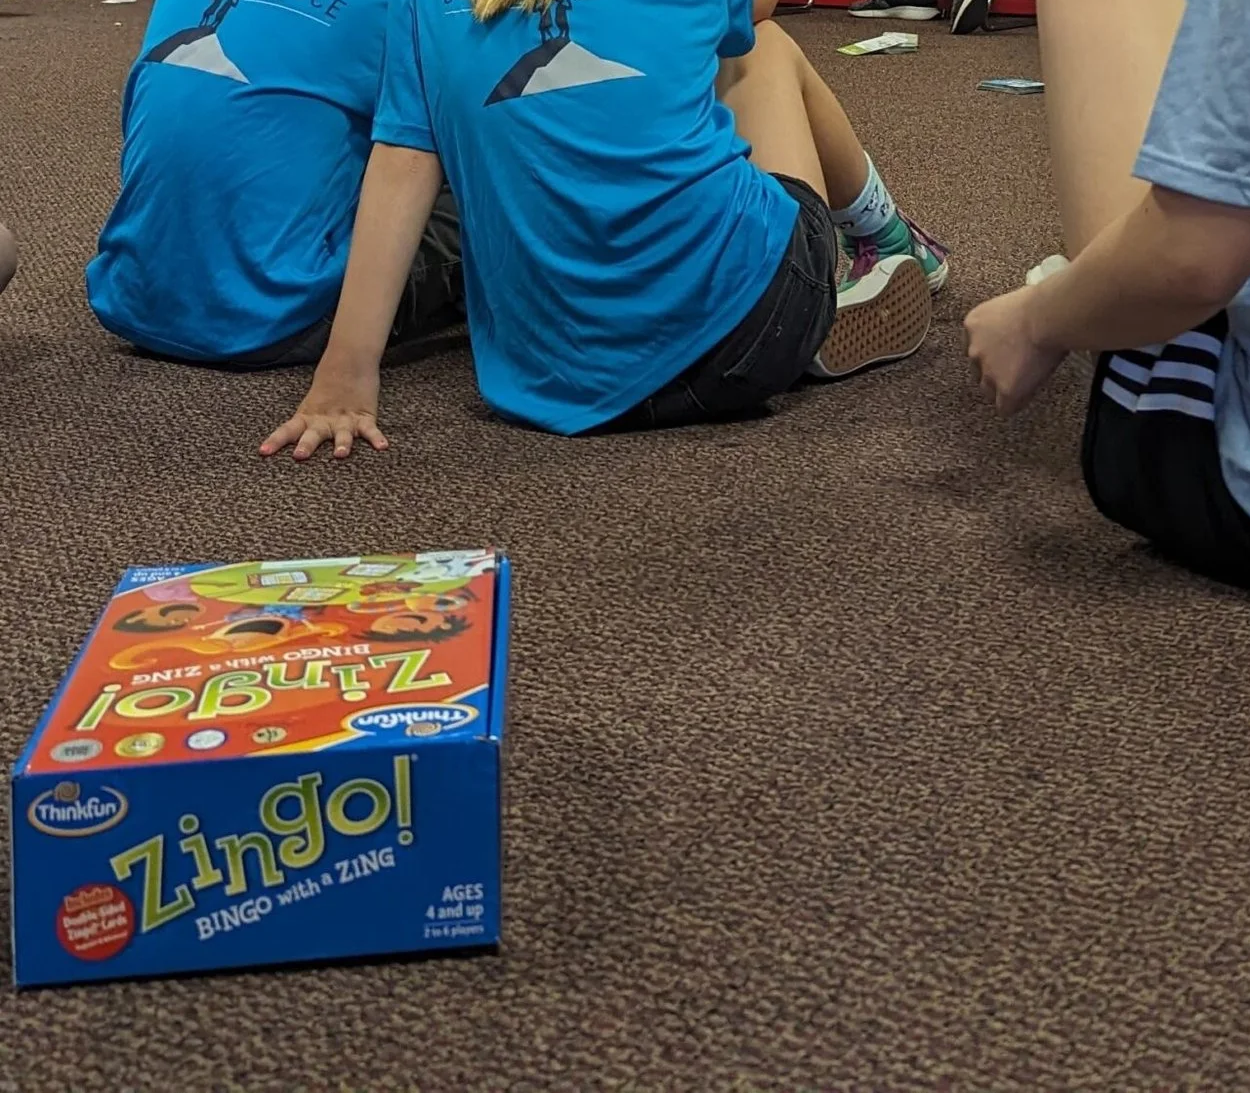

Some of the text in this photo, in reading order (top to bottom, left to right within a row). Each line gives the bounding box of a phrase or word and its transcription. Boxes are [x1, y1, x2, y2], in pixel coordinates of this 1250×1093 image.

[283, 644, 370, 659] BINGO
[225, 655, 275, 668] with
[133, 665, 202, 684] ZING
[76, 649, 452, 733] Zingo!
[358, 711, 465, 728] Thinkfun
[37, 797, 118, 822] Thinkfun
[110, 754, 414, 933] Zingo!
[196, 847, 395, 941] BINGO with a ZING
[442, 883, 484, 902] AGES
[425, 901, 484, 920] 4 and up
